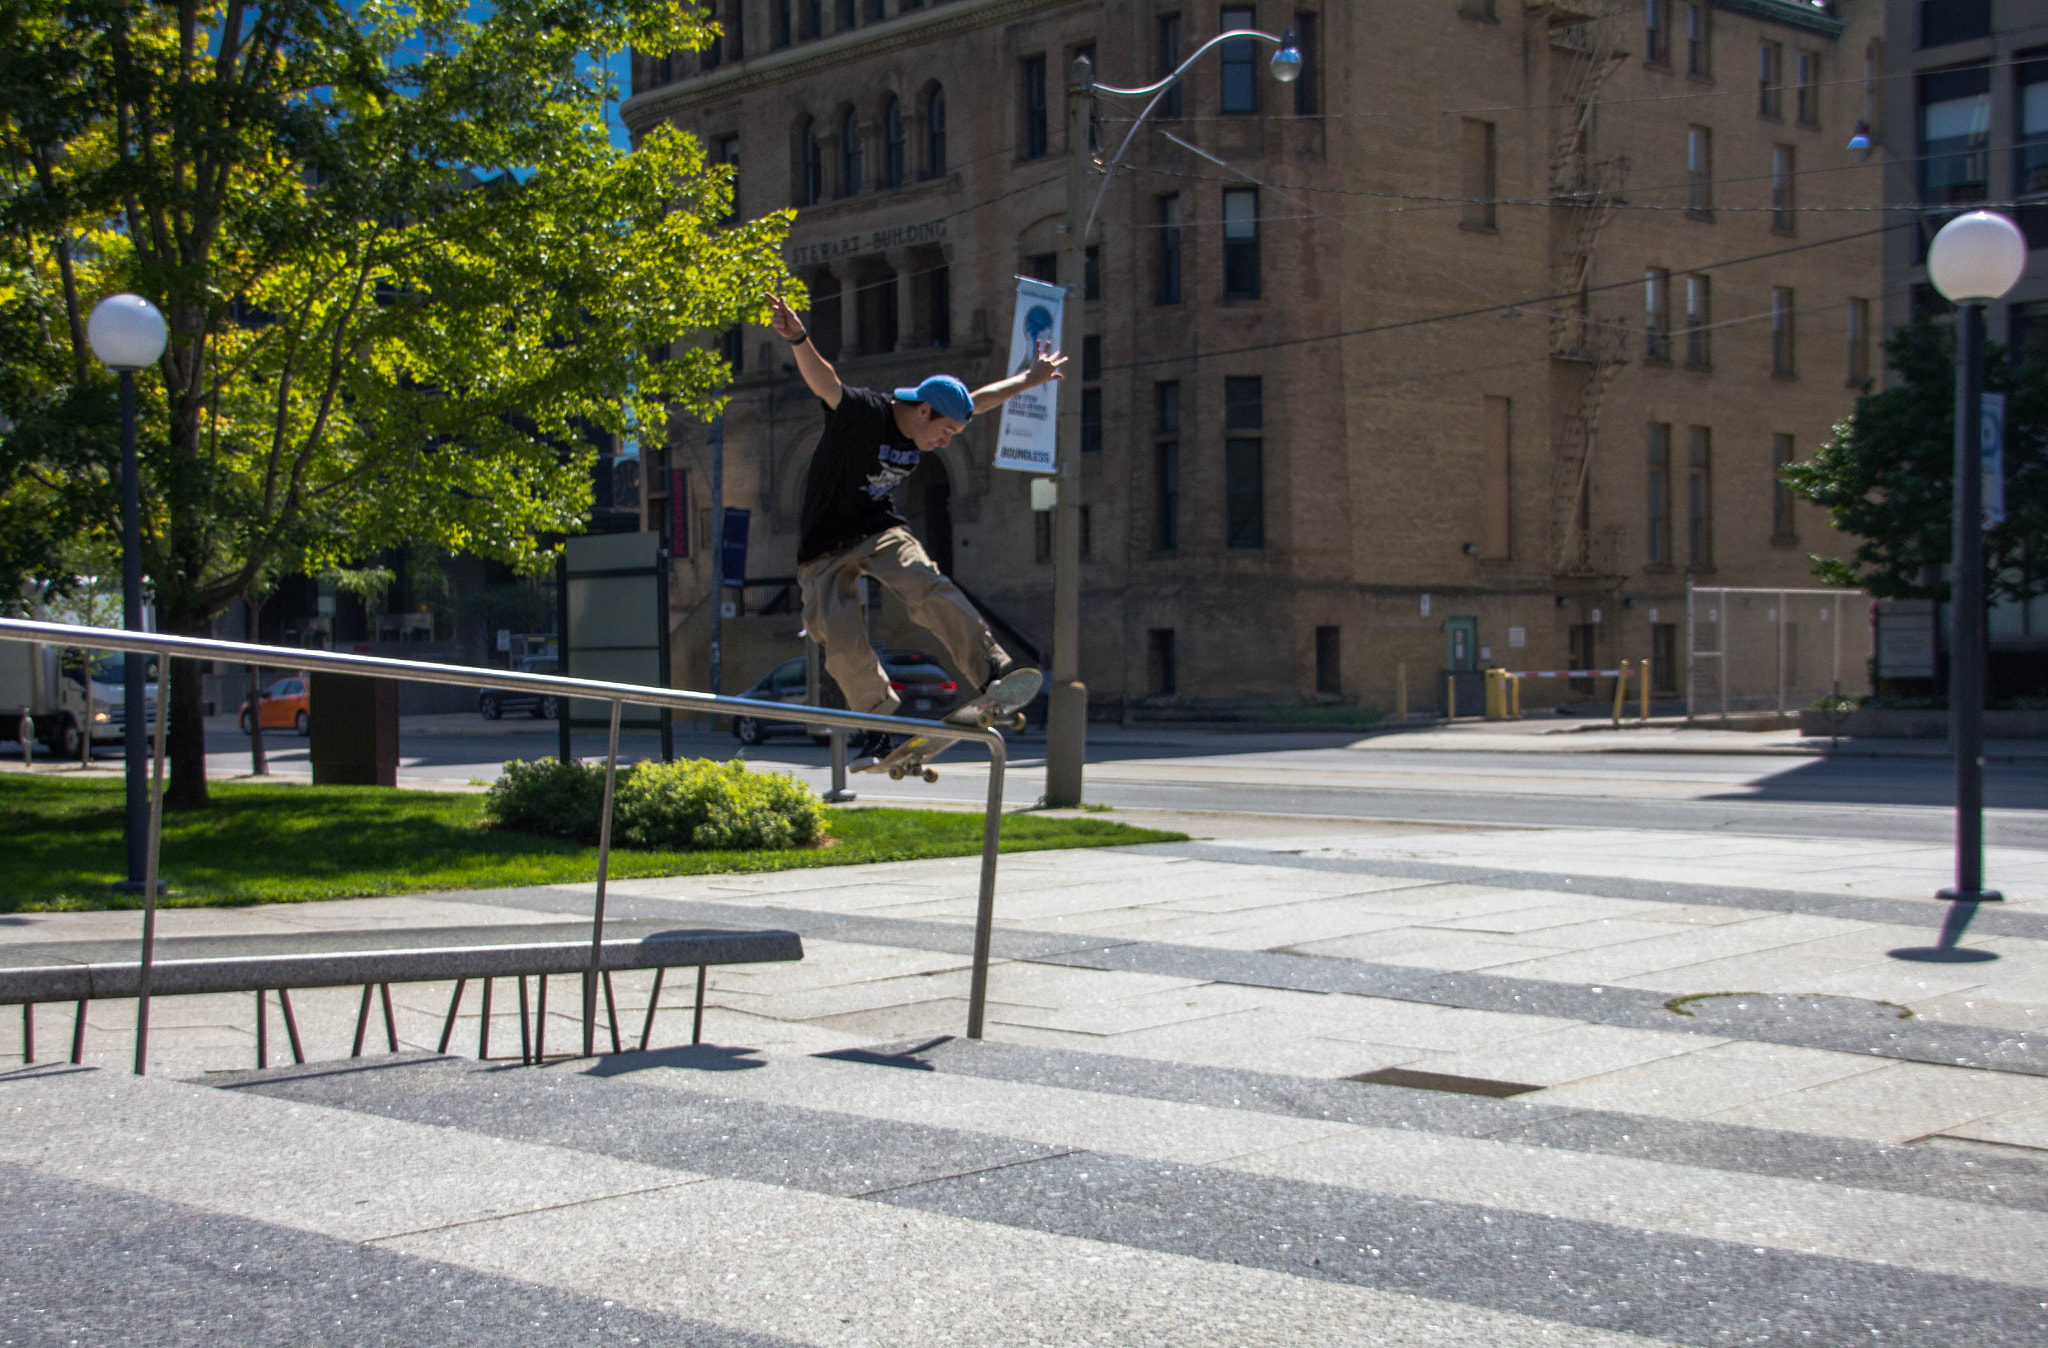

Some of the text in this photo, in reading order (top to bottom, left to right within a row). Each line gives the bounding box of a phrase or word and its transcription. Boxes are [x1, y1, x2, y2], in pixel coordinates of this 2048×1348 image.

[791, 219, 947, 264] STEWART BUILDING
[1001, 446, 1050, 463] BOUNDLESS
